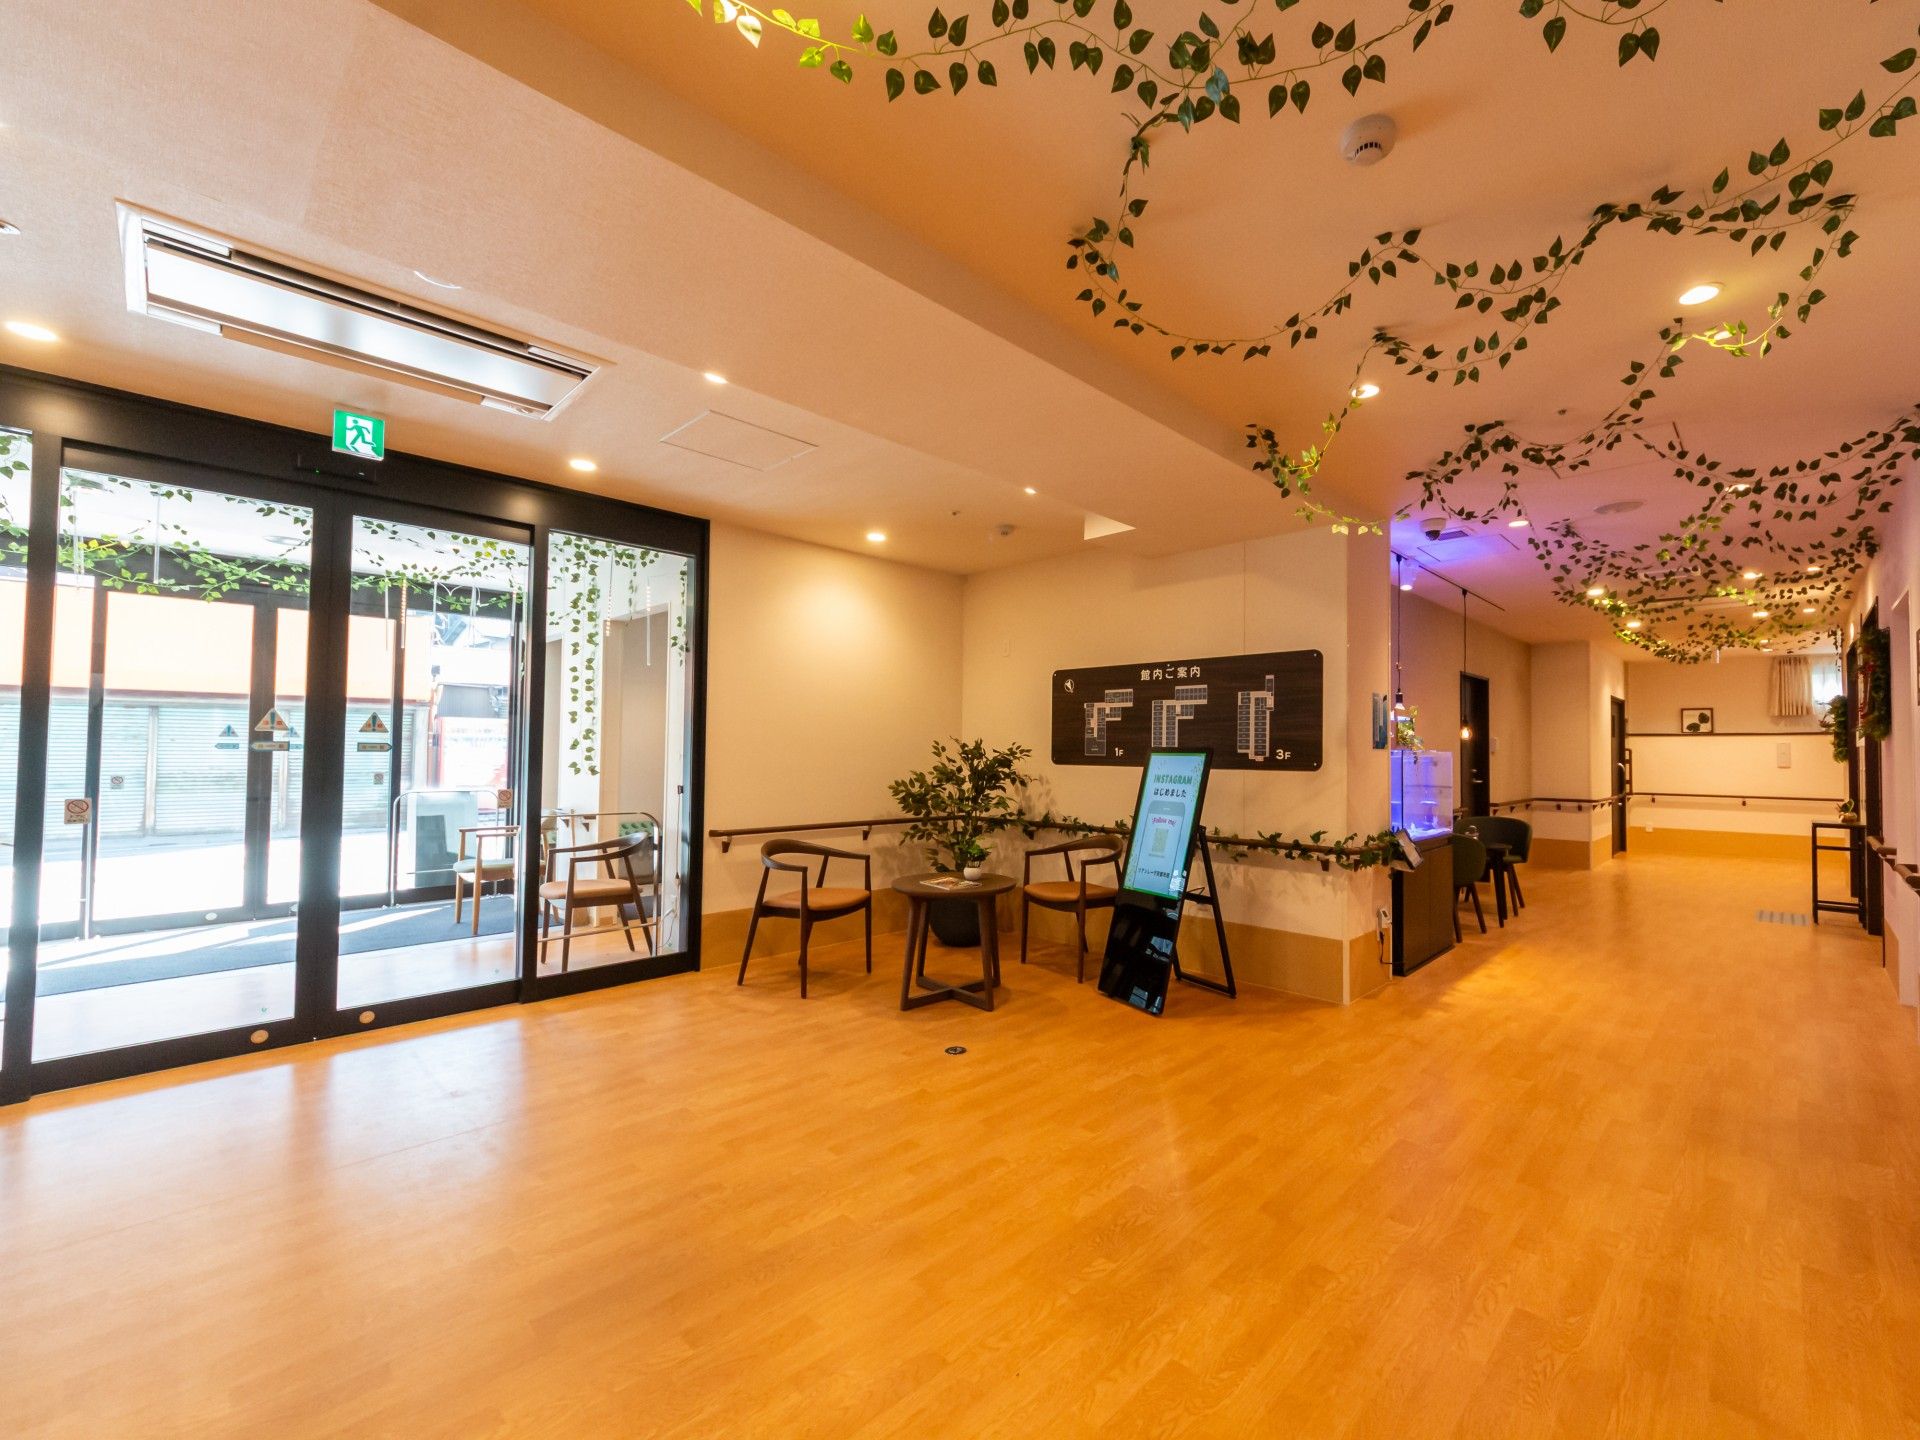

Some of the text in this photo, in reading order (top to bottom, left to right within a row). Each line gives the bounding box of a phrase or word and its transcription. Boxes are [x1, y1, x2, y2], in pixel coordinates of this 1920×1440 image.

[1140, 665, 1201, 681] 館内ご案内
[1114, 747, 1124, 757] 1F
[1275, 749, 1292, 760] 3F
[1153, 774, 1193, 785] INSTAGRAM
[1153, 787, 1187, 798] はじめました
